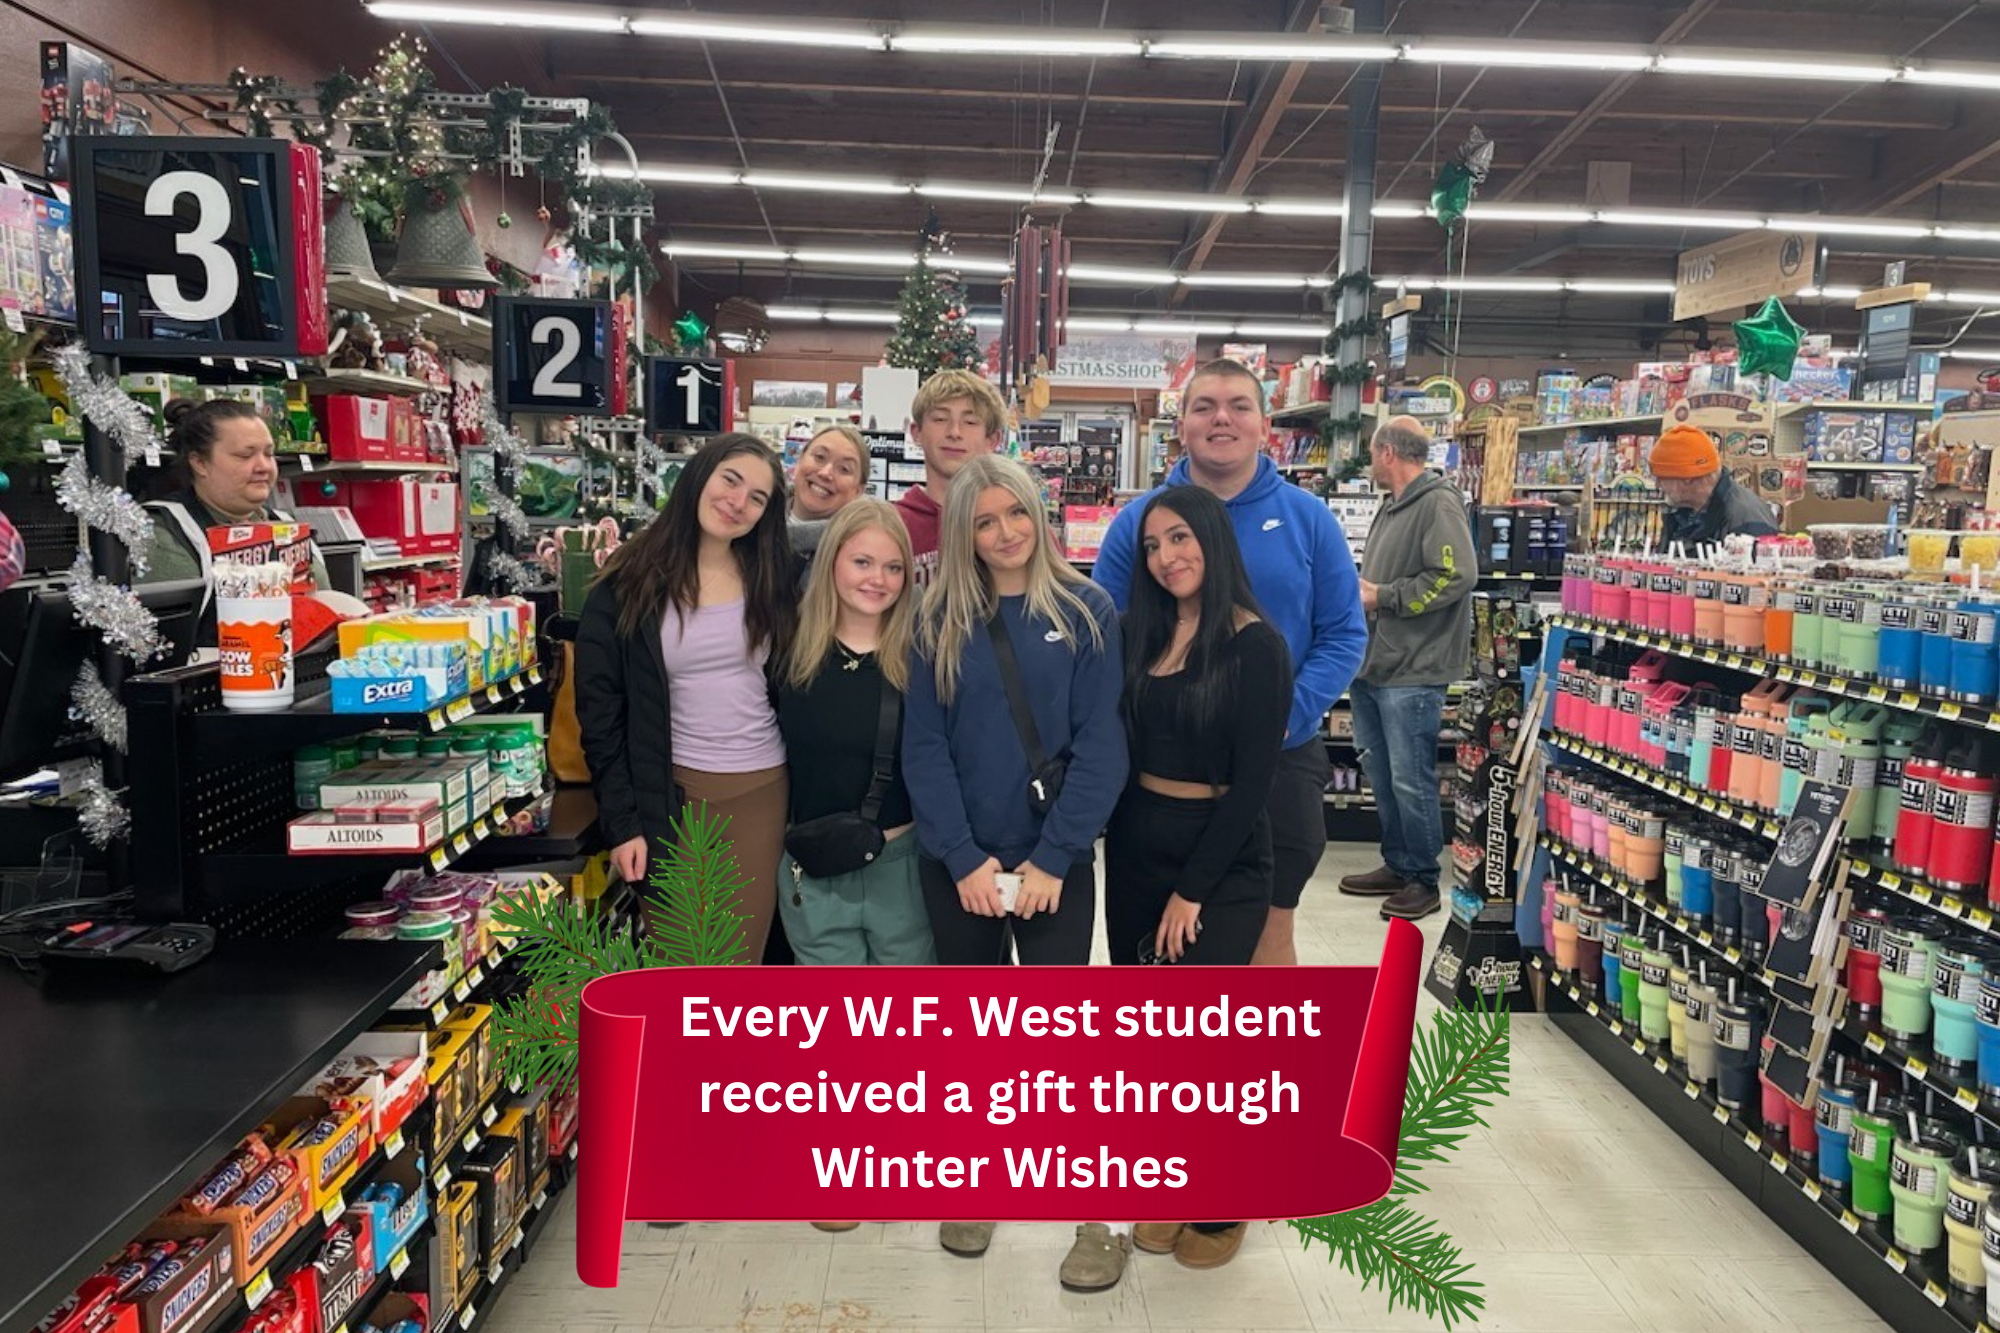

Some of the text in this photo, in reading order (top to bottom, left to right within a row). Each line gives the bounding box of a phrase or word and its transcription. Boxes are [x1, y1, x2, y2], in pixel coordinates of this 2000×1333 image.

[143, 170, 239, 321] 3
[1682, 255, 1716, 285] TOYS
[1888, 268, 1899, 287] 3
[531, 316, 583, 399] 2
[676, 366, 702, 424] 1
[1690, 394, 1750, 411] FLASKS
[220, 651, 251, 664] COW
[364, 680, 413, 704] Extra
[355, 789, 408, 800] ALTOIDS
[327, 829, 384, 843] ALTOIDS
[1486, 827, 1507, 897] ENERGY
[251, 1207, 286, 1256] SNICKERS
[163, 1269, 209, 1331] SNICKERS
